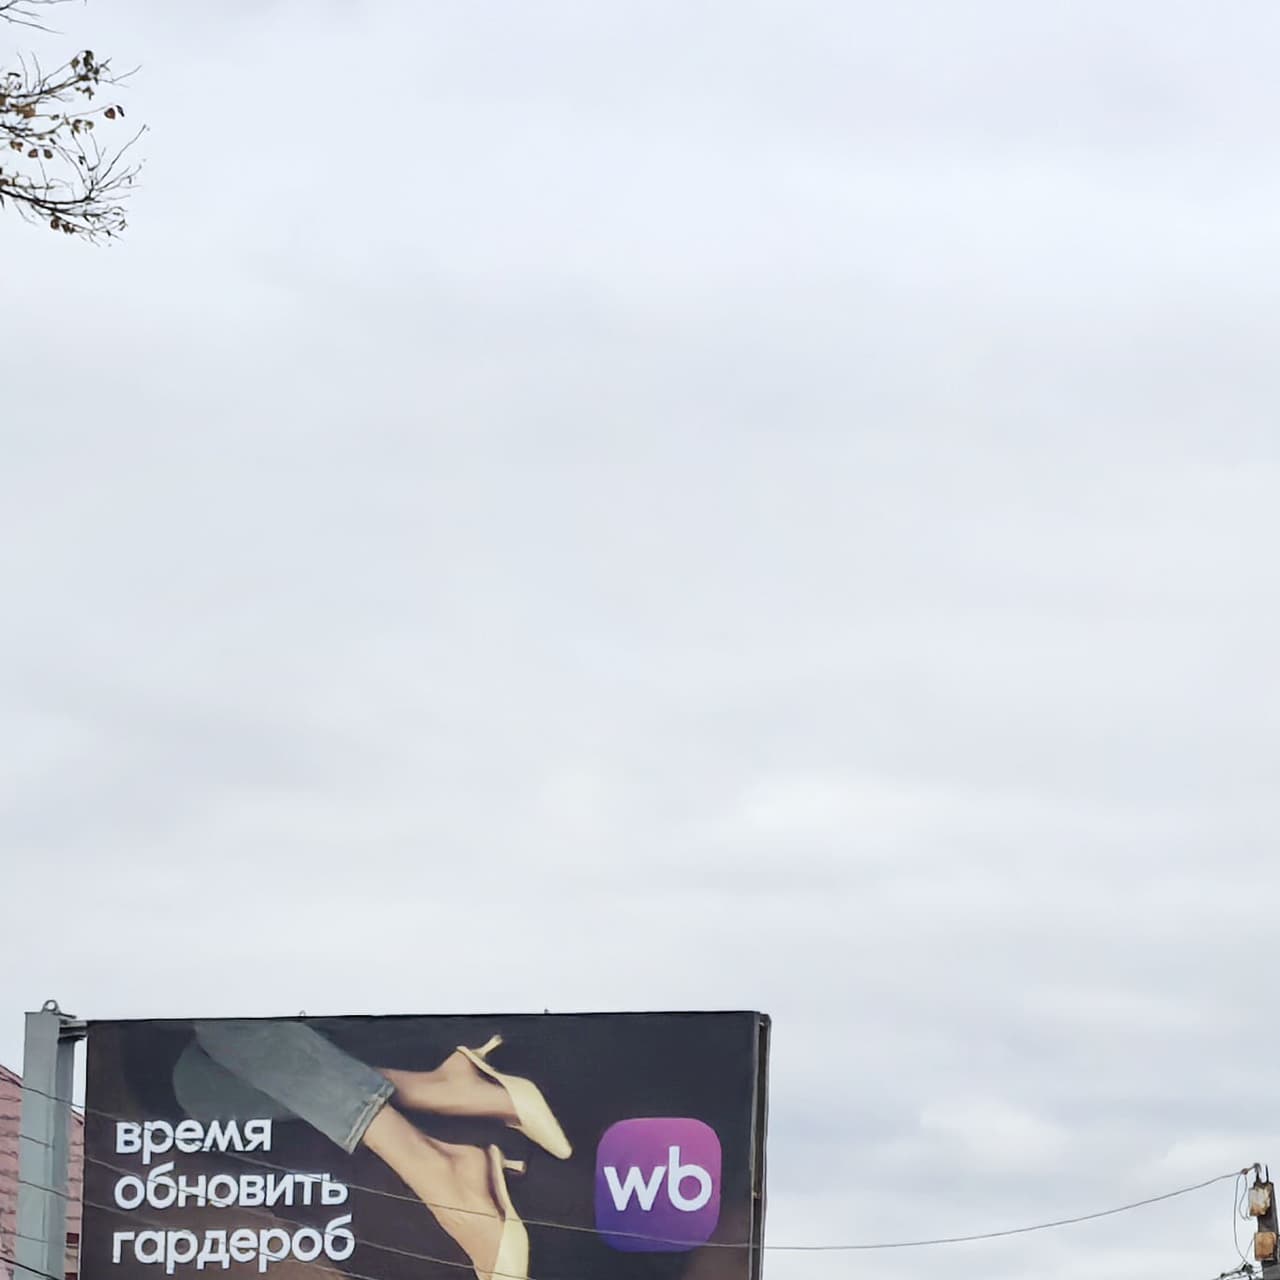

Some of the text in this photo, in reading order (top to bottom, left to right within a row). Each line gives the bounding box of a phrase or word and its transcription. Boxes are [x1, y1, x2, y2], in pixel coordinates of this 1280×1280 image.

[115, 1118, 273, 1165] время
[113, 1161, 349, 1210] обновить
[603, 1145, 713, 1212] wb
[112, 1213, 355, 1275] гардероб
